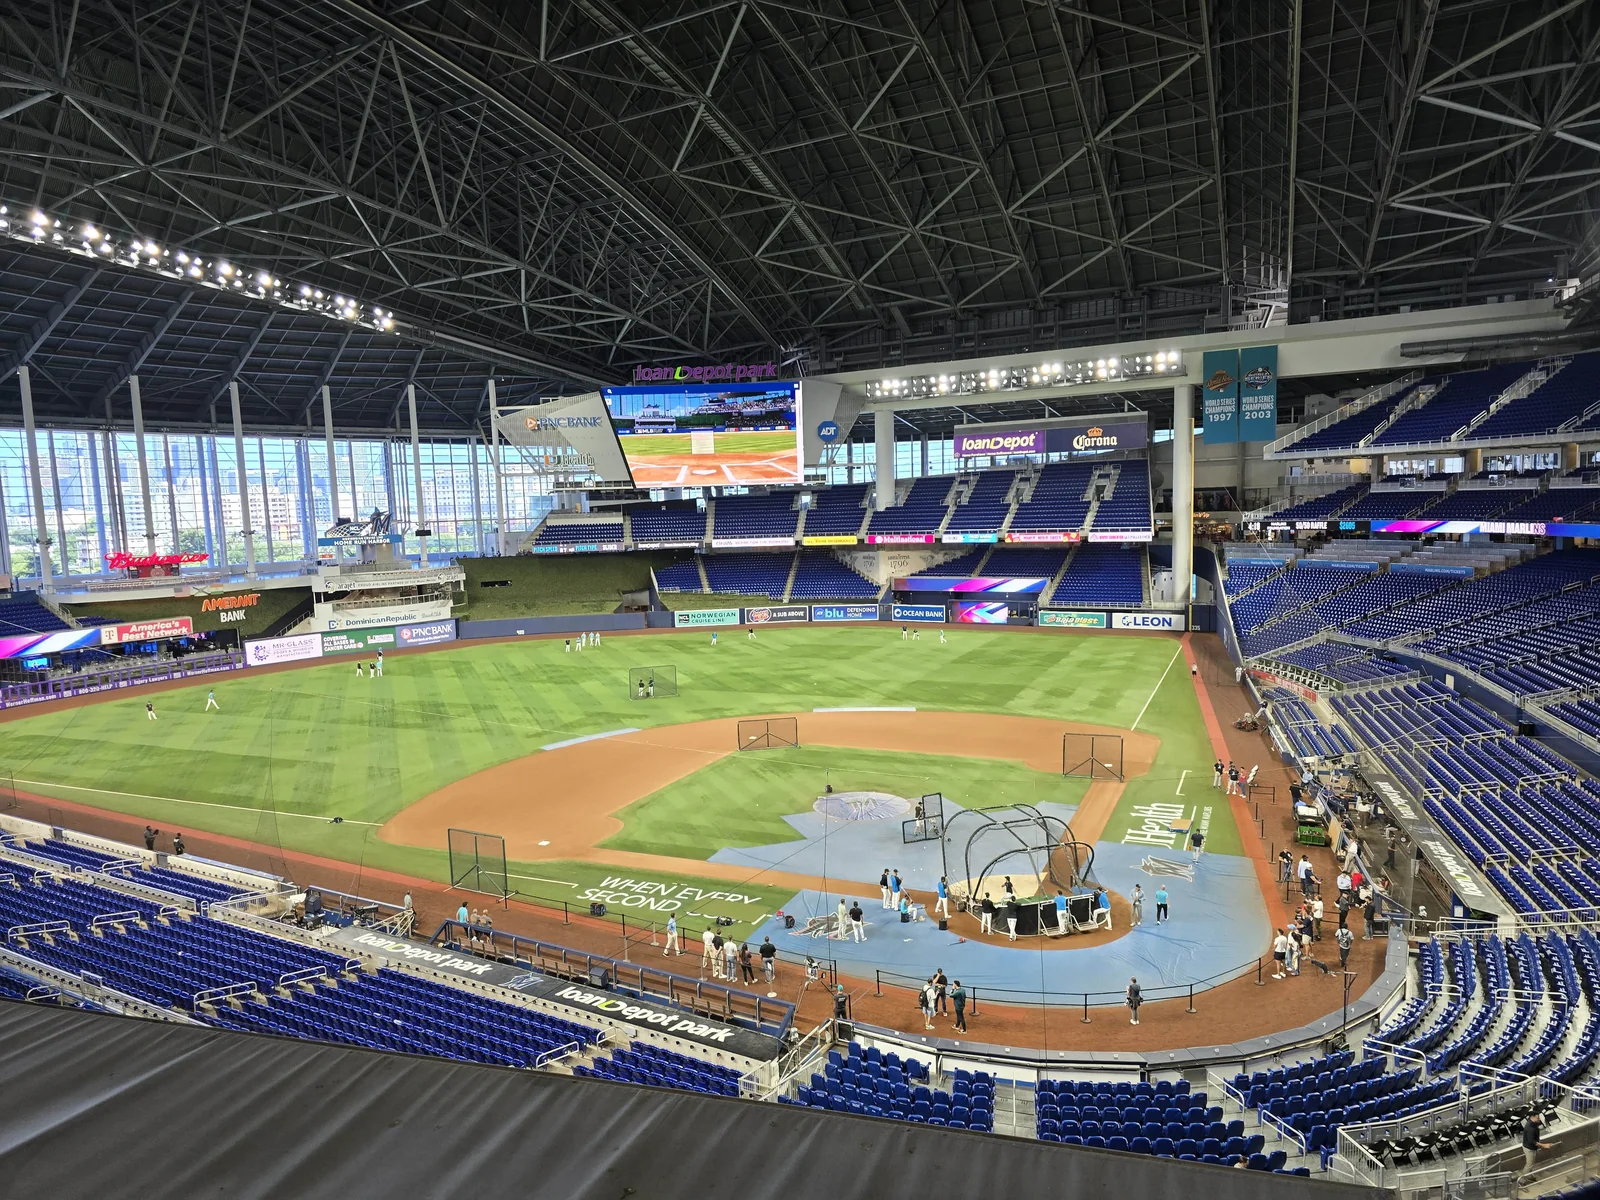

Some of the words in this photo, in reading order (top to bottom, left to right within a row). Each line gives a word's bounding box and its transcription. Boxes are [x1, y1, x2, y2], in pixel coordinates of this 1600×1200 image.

[636, 362, 733, 381] loanDepot
[735, 361, 777, 380] park
[1205, 405, 1235, 414] CHAMPIONS
[1242, 403, 1274, 411] CHAMPIONS
[1209, 413, 1232, 422] 1997
[1245, 411, 1271, 419] 2003
[820, 427, 836, 436] ADT
[962, 433, 1035, 451] loanDepot
[1072, 434, 1118, 450] Corona
[1295, 522, 1310, 530] 50/50
[1480, 522, 1505, 533] MIAMI
[1506, 522, 1546, 535] MARLINS
[883, 535, 925, 543] Multinational
[104, 551, 210, 569] Budweiser
[890, 560, 908, 569] 1796
[337, 580, 355, 591] arajet
[202, 594, 258, 612] AMERANT
[220, 609, 246, 623] BANK
[825, 608, 843, 618] blu
[926, 610, 943, 618] BANK
[130, 620, 180, 634] America's
[1134, 617, 1172, 627] LEON
[122, 630, 145, 641] Best
[147, 626, 188, 640] Network
[600, 876, 677, 896] WHEN
[675, 887, 762, 905] EVERY
[578, 889, 682, 912] SECOND
[353, 933, 451, 964] loanDepot
[437, 957, 493, 975] park
[554, 986, 680, 1026] loanDepot
[667, 1019, 736, 1042] park
